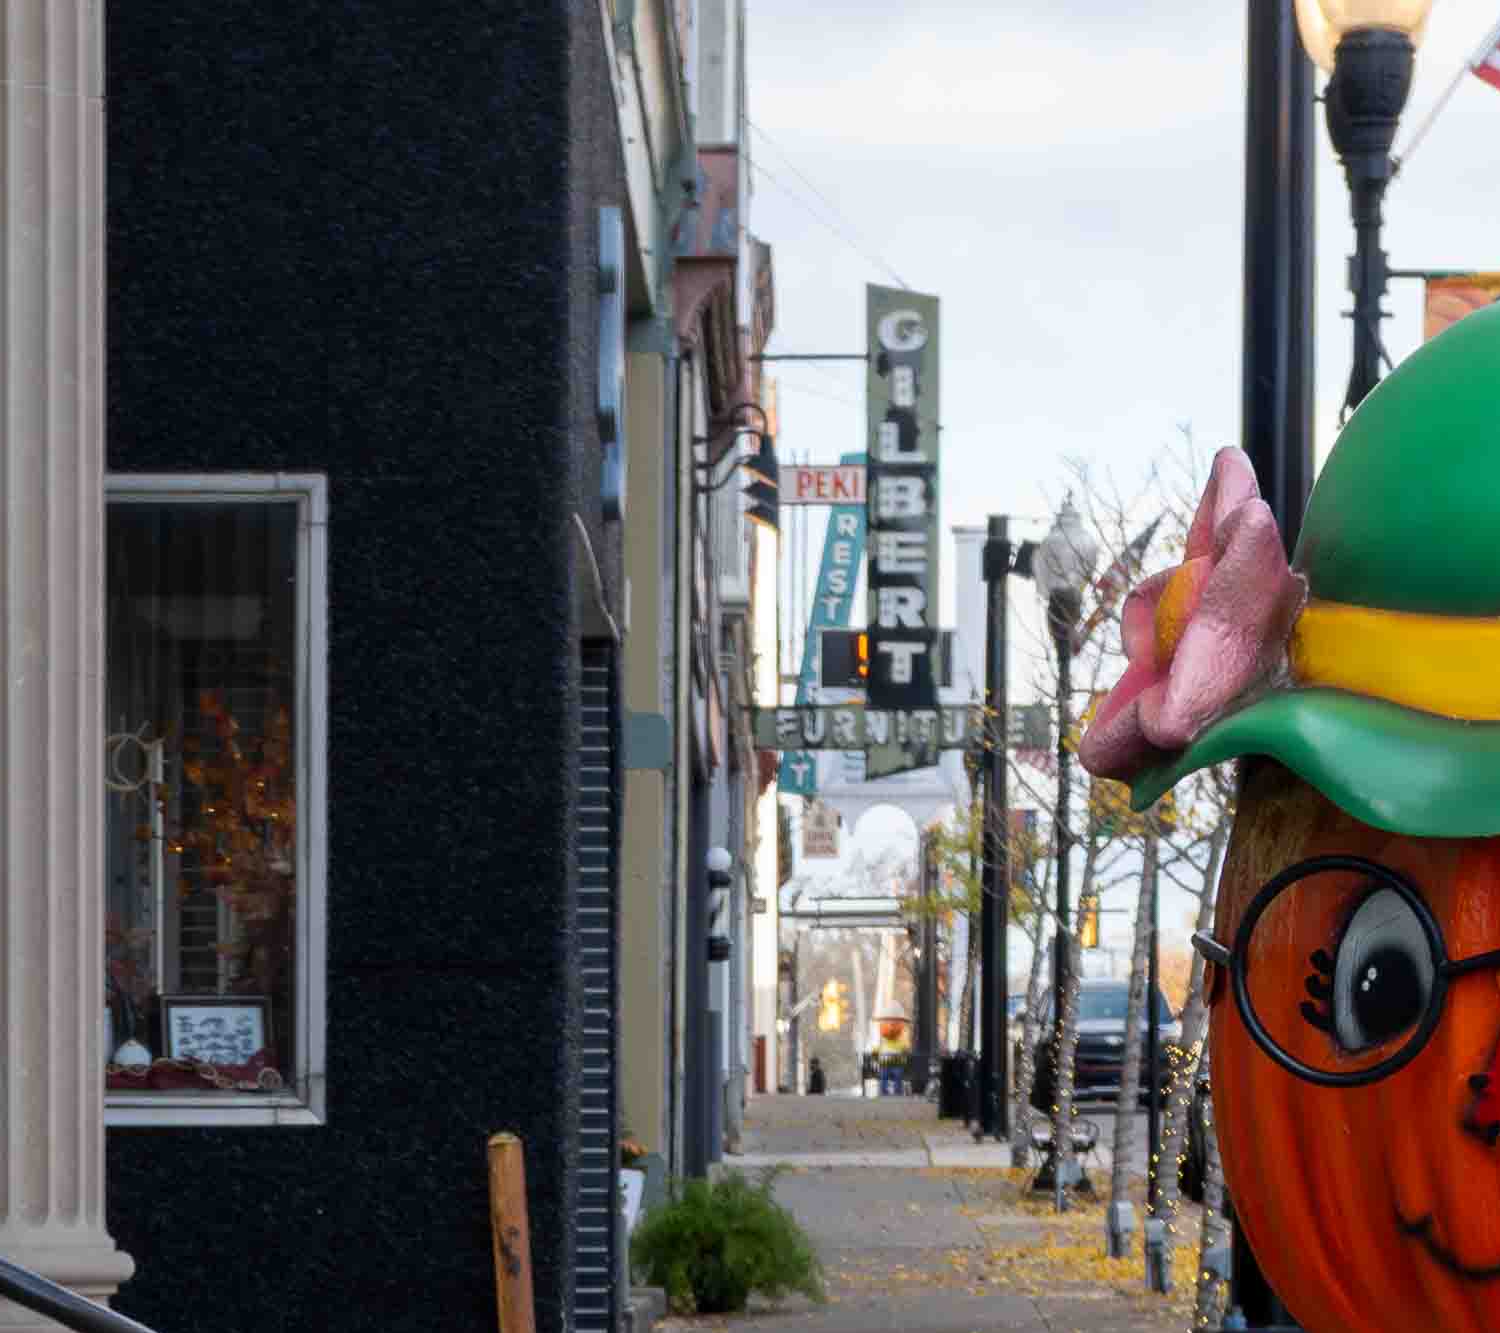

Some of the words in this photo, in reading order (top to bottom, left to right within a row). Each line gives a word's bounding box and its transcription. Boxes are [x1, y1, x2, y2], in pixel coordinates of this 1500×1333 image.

[797, 470, 859, 498] PEKI
[876, 310, 928, 684] GILBERT
[775, 707, 1025, 746] FURNITUE
